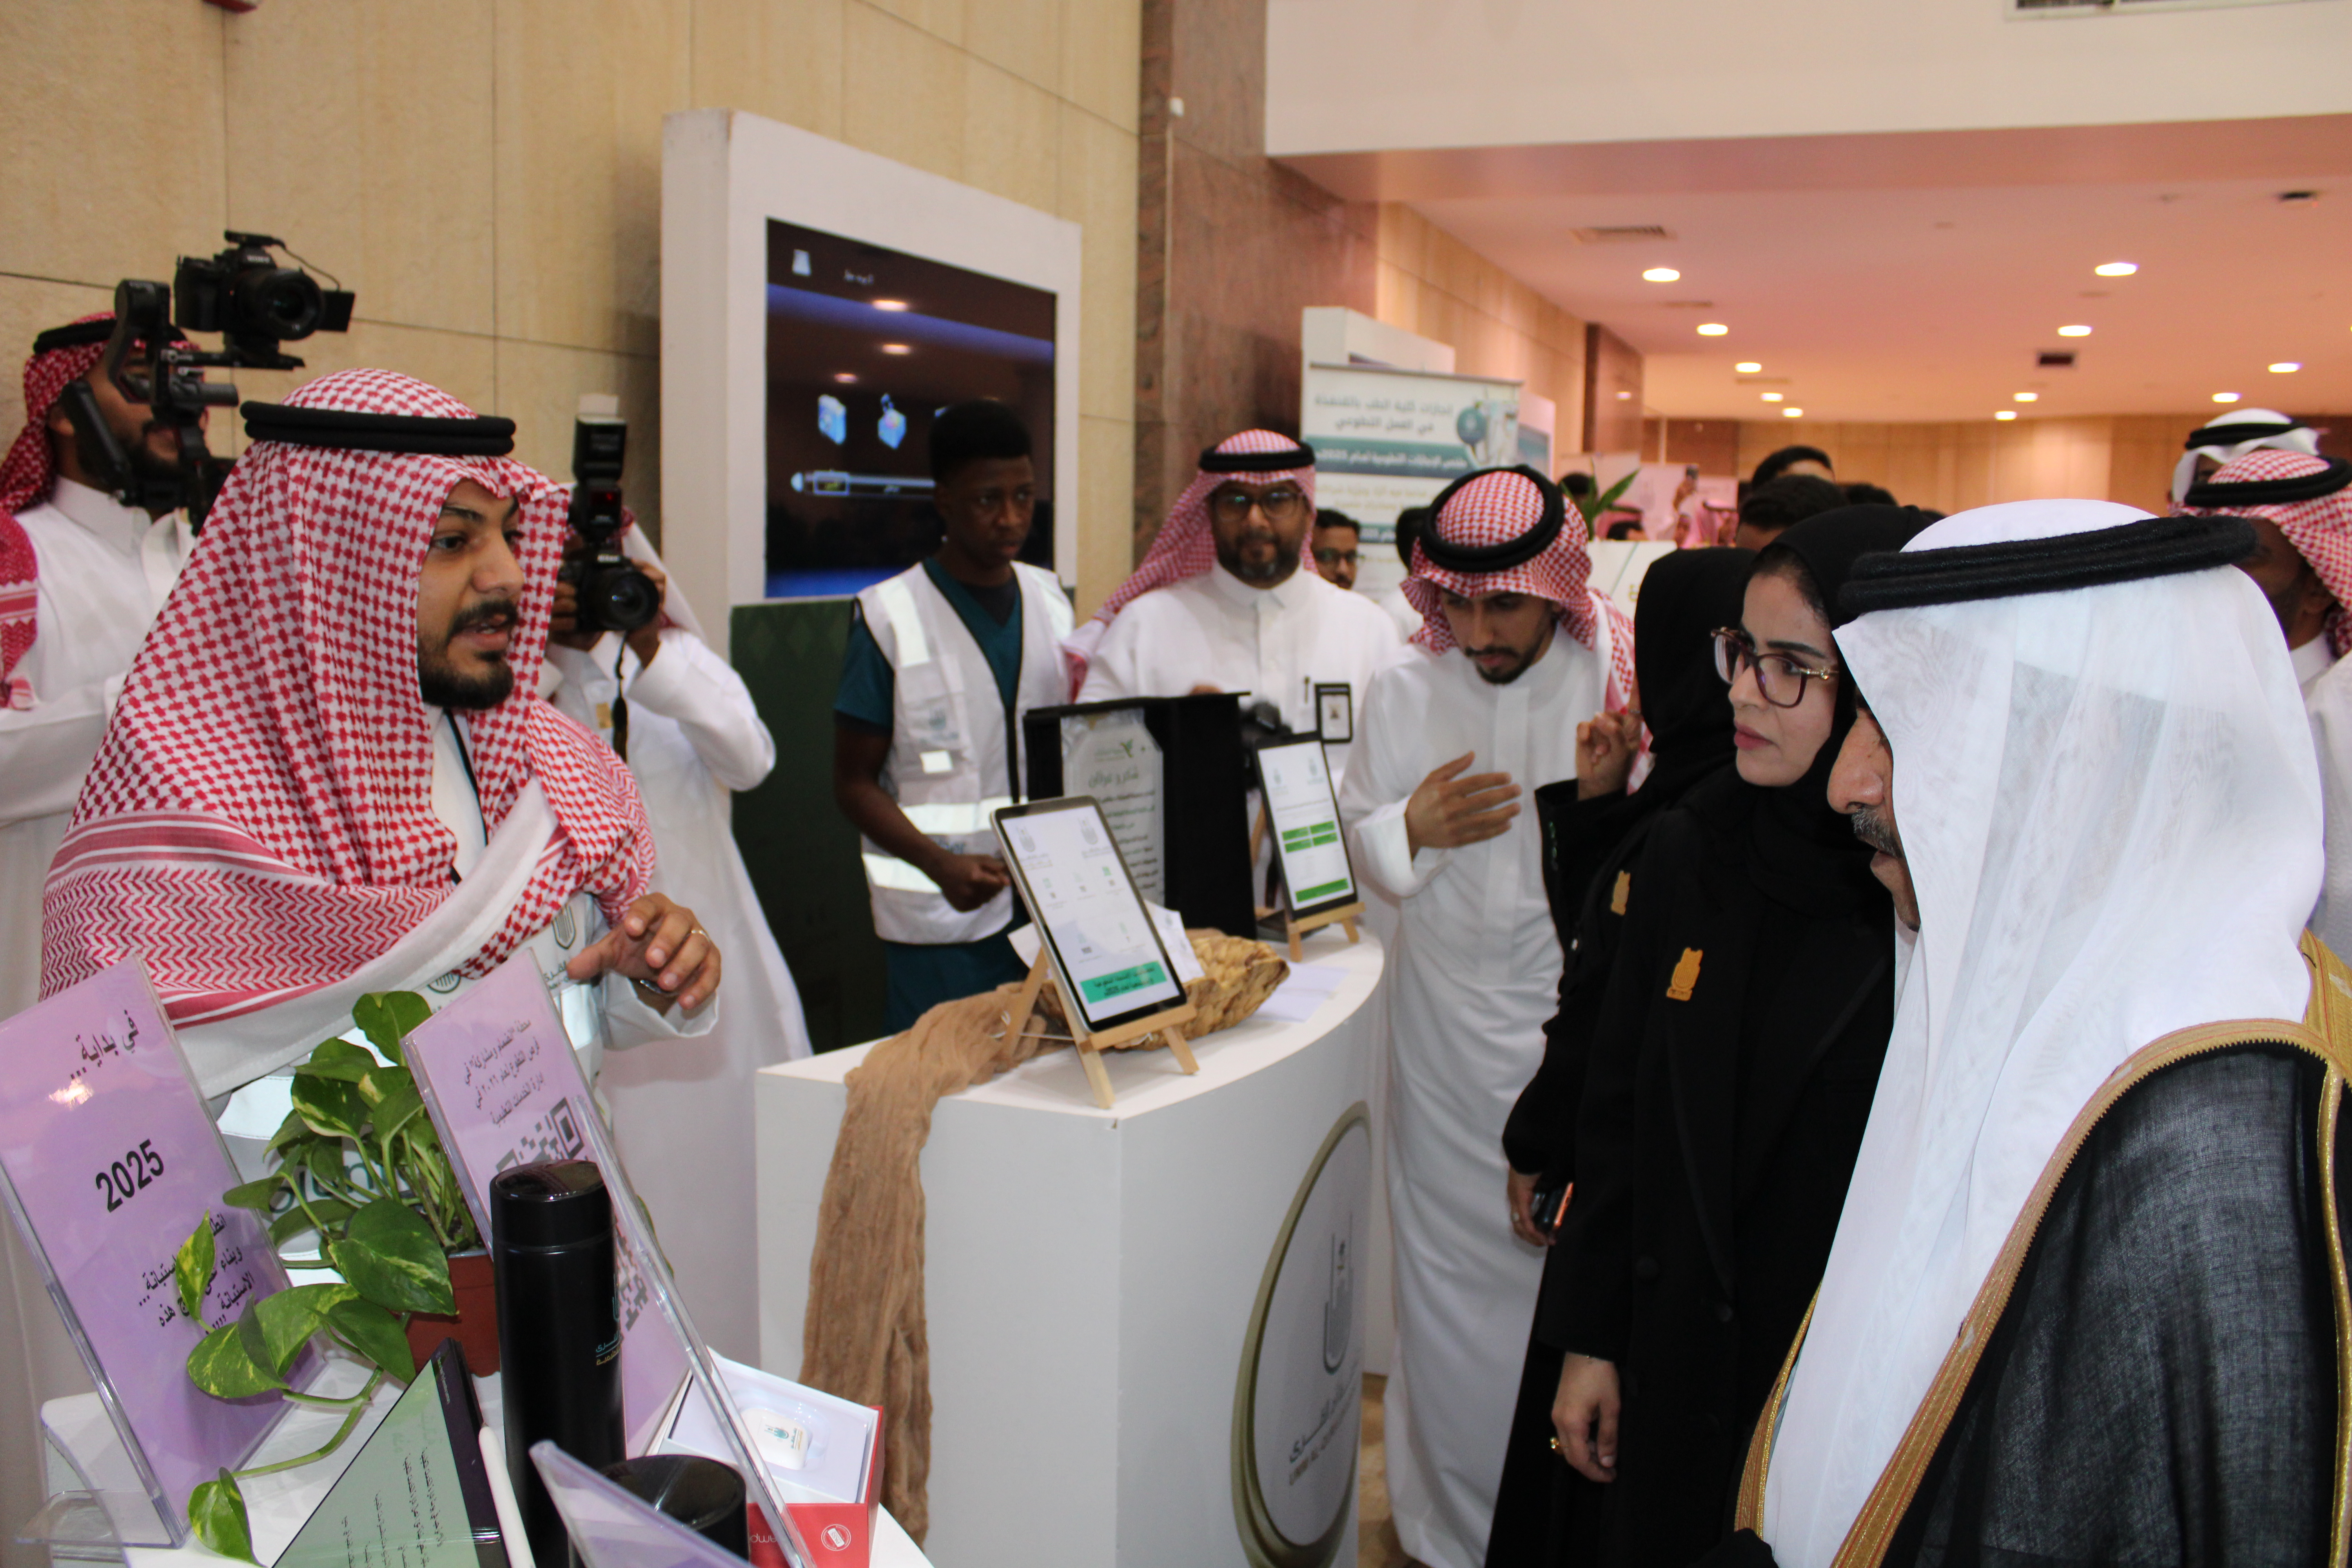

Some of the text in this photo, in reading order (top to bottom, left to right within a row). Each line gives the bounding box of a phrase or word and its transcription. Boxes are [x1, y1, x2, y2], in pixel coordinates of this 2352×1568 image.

[122, 1009, 139, 1054] في
[96, 1138, 164, 1213] 2025
[221, 1246, 243, 1272] وبناء
[159, 1303, 176, 1327] هذه
